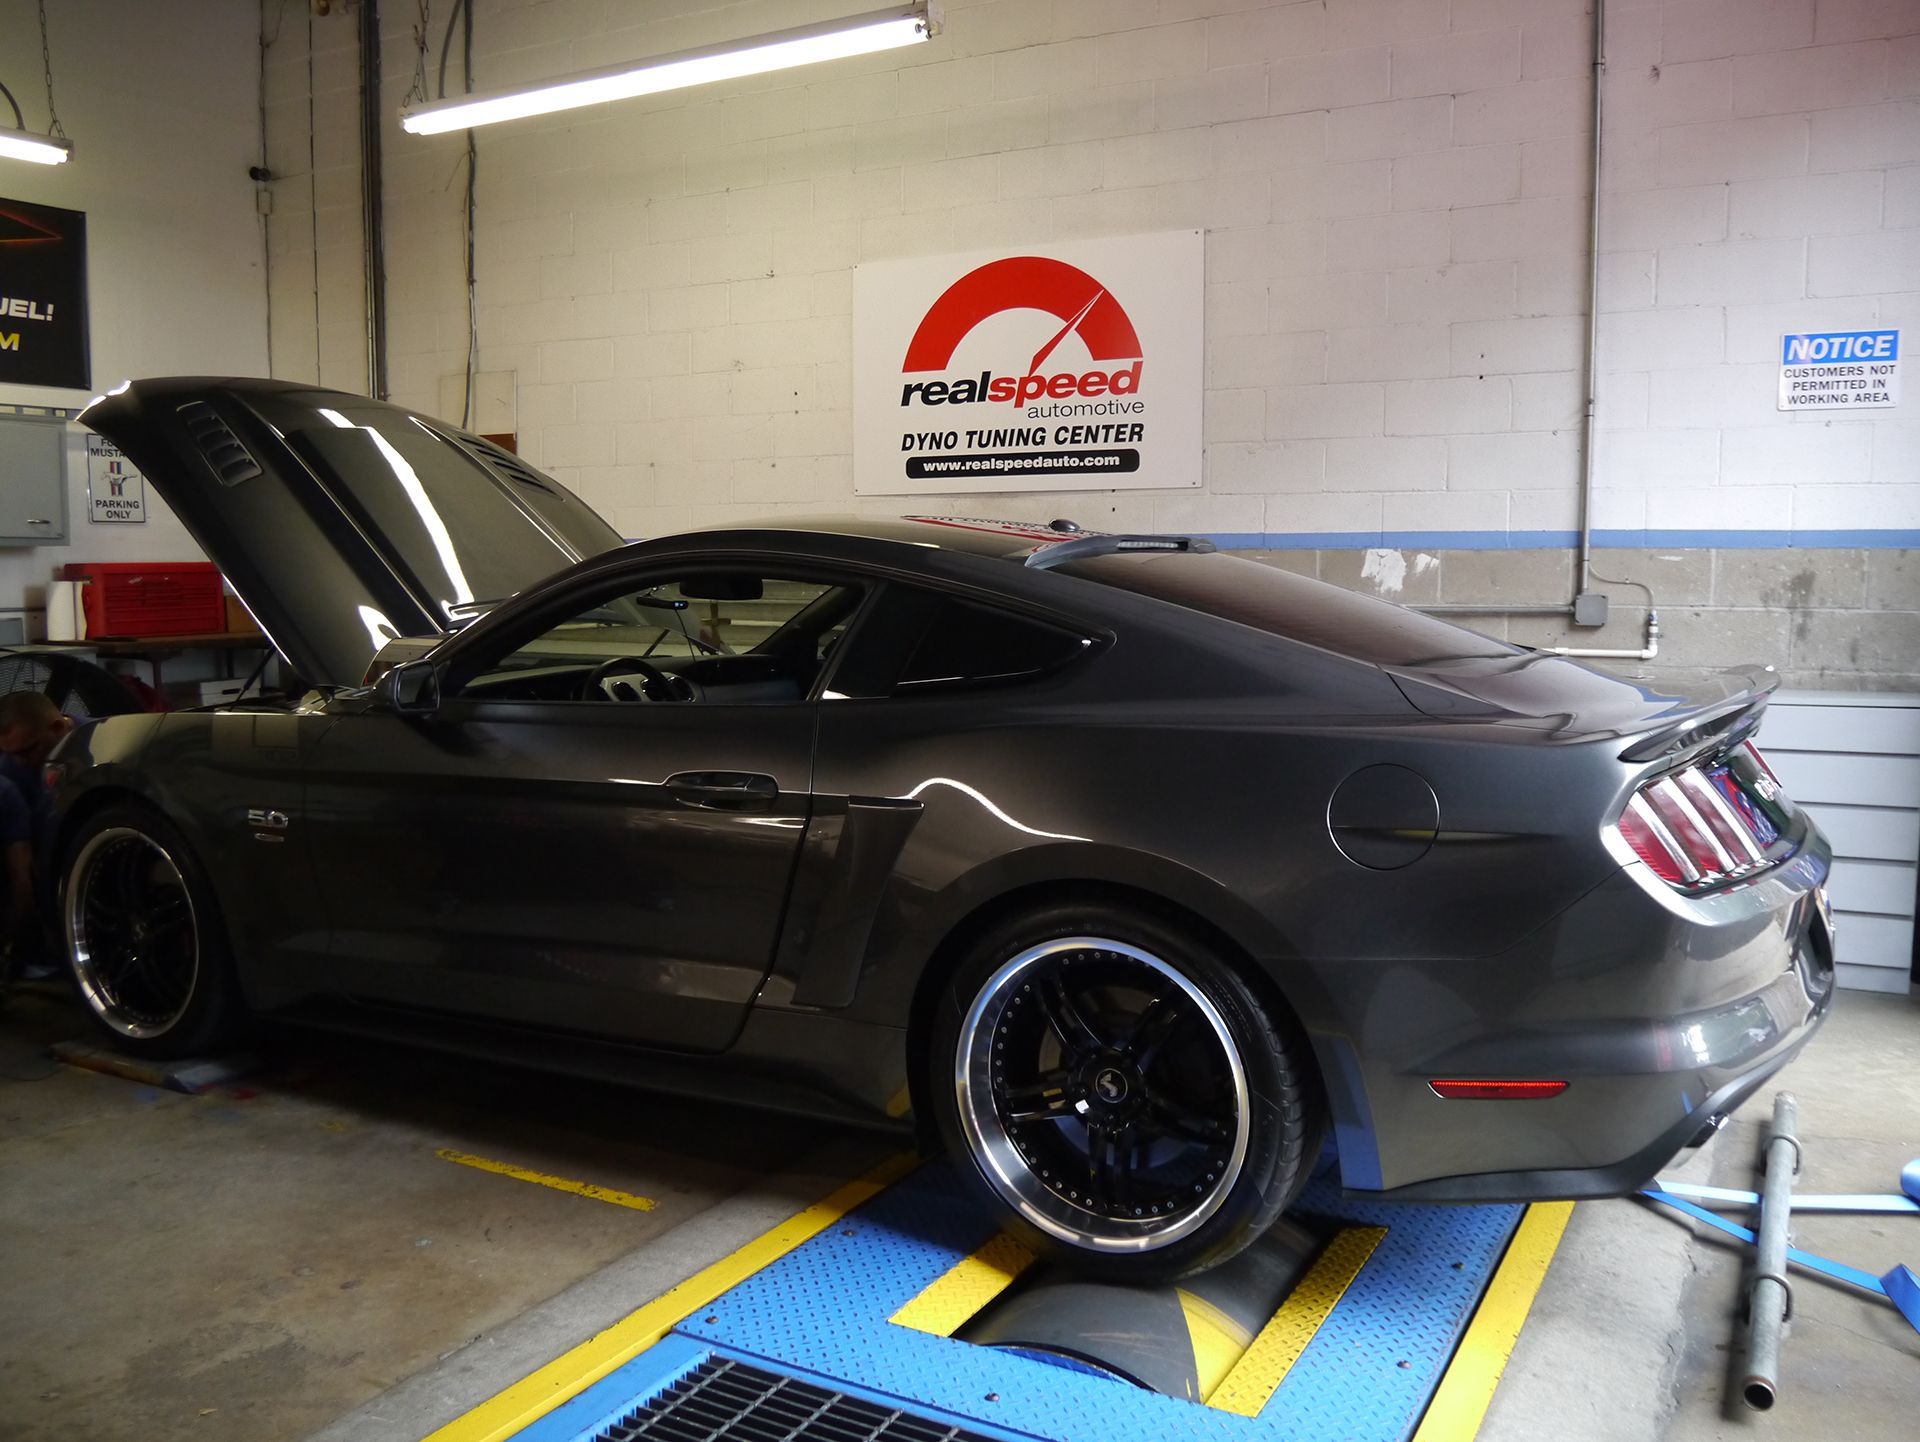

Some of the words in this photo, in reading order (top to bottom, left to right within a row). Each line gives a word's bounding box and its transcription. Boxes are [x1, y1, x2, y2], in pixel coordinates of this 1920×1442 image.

[1787, 335, 1895, 361] NOTICE
[1784, 366, 1865, 378] CUSTOMERS
[1870, 365, 1896, 376] NOT
[901, 361, 1144, 408] realspeed
[1792, 379, 1867, 392] PERMITTED
[1872, 379, 1886, 389] IN
[1787, 393, 1849, 405] WORKING
[1854, 392, 1890, 403] AREA
[1027, 399, 1145, 419] automotive
[901, 431, 959, 451] DYNO
[965, 427, 1047, 448] TUNING
[1054, 423, 1145, 445] CENTER
[923, 456, 1120, 472] www.realspeedauto.com
[95, 500, 140, 509] PARKING
[106, 510, 132, 519] ONLY
